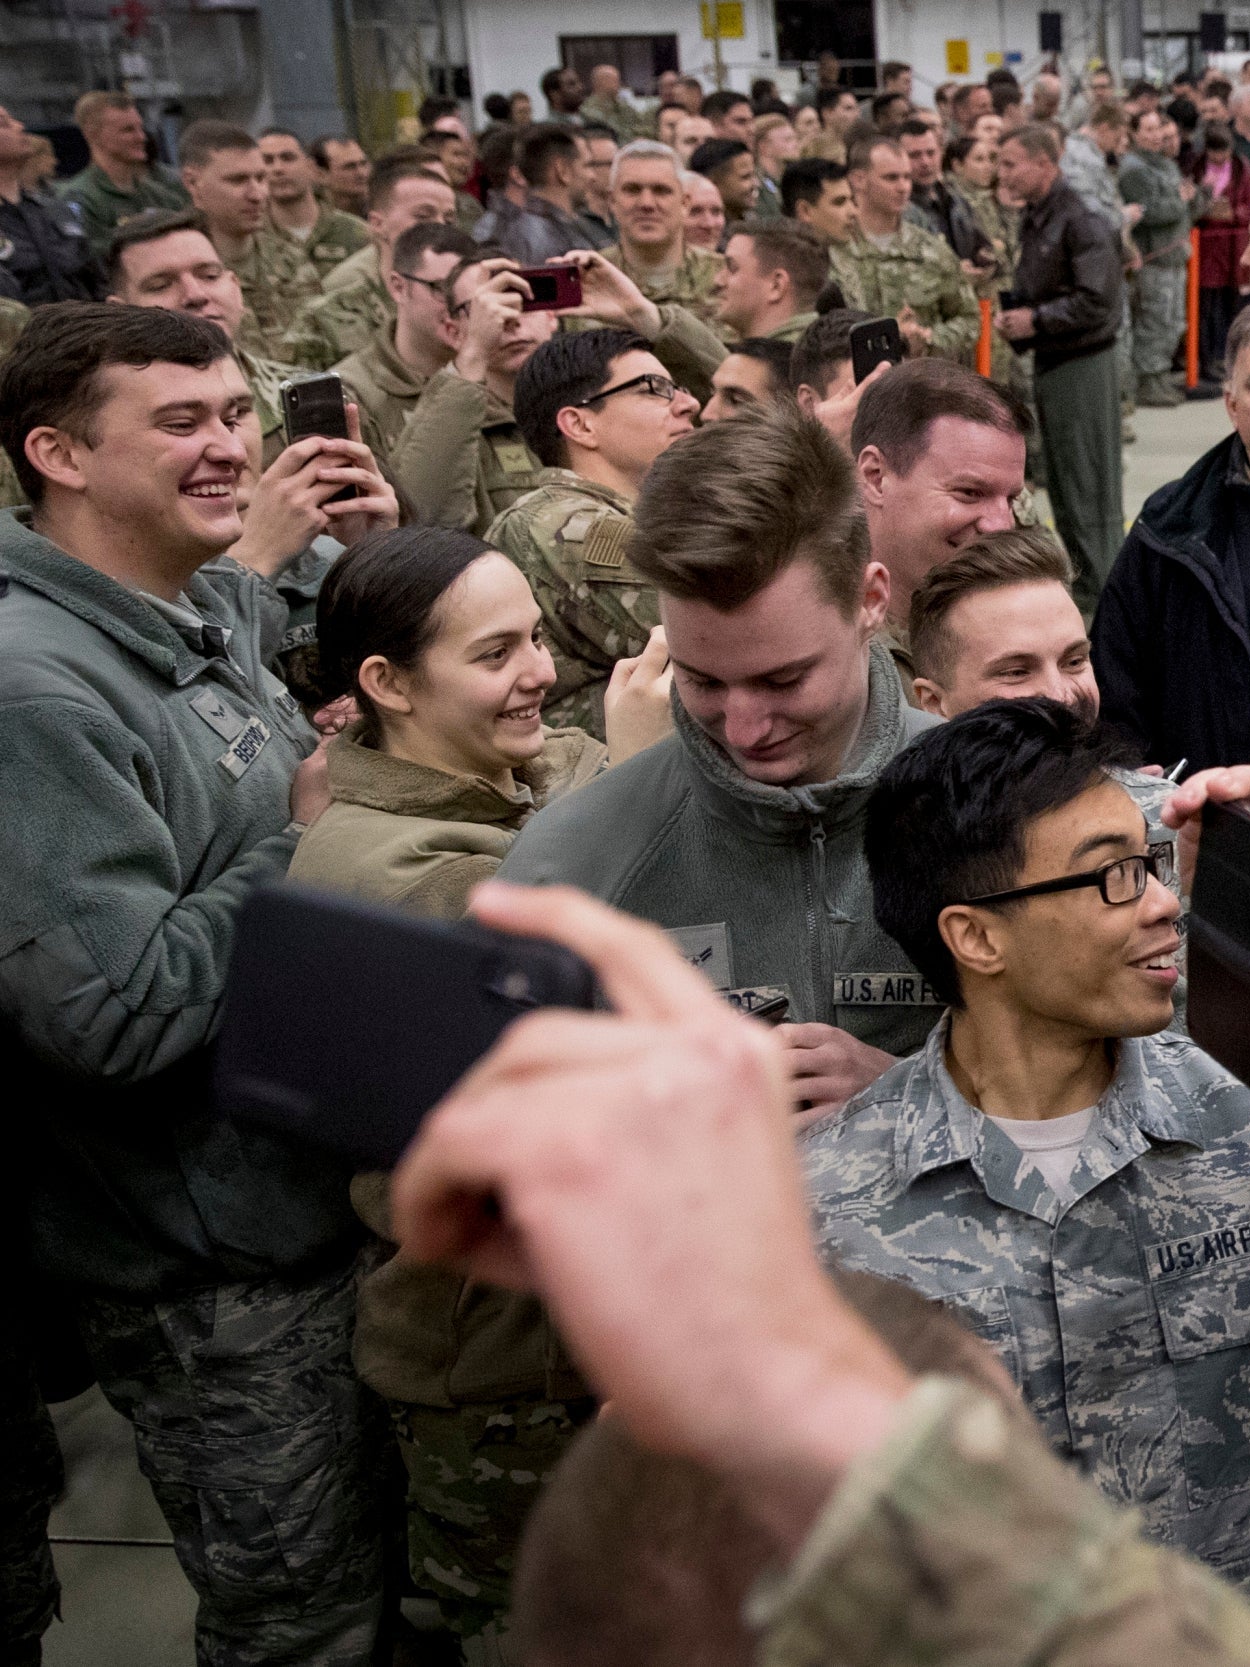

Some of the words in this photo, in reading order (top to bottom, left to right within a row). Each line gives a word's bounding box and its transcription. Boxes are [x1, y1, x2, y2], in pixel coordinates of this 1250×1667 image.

[232, 724, 267, 764] BEDFORD
[841, 978, 877, 1002] U.S.
[882, 977, 915, 1002] AIR
[1156, 1240, 1200, 1274] U.S.
[1202, 1229, 1240, 1264] AIR
